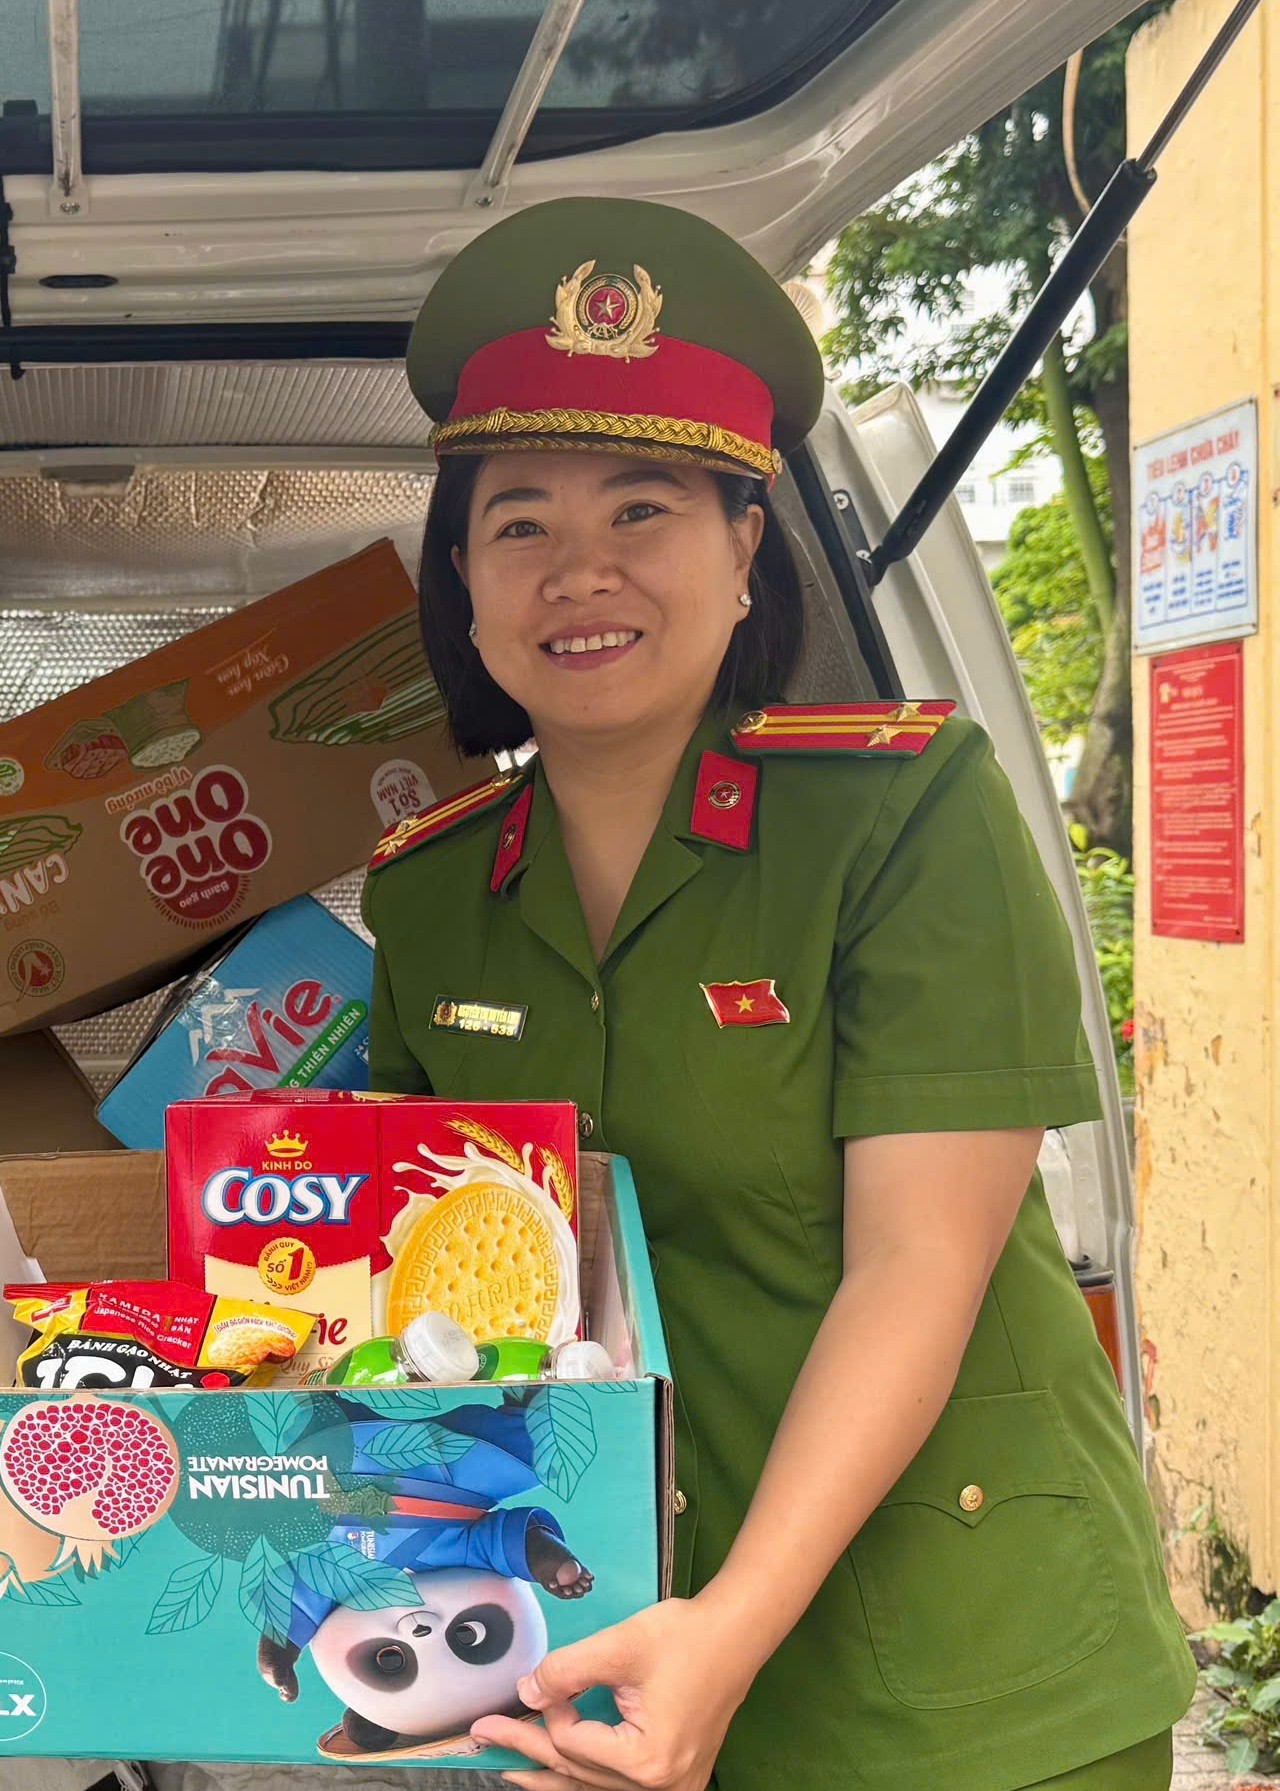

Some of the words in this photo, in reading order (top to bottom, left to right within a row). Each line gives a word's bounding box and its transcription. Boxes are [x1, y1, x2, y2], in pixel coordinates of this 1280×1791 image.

[123, 768, 246, 856] One
[143, 817, 270, 896] One
[205, 979, 335, 1096] aVie
[297, 1043, 330, 1079] THIÊN
[327, 1007, 361, 1047] NHIÊN
[262, 1161, 292, 1171] KINH
[294, 1161, 313, 1171] DO
[201, 1166, 370, 1226] COSY
[288, 1247, 305, 1281] 1
[94, 1306, 136, 1323] Japanese
[138, 1321, 155, 1336] Rice
[157, 1334, 192, 1349] Cracker
[99, 1293, 161, 1322] KAMEDA
[67, 1338, 118, 1353] BÁNH
[117, 1344, 149, 1357] GẠO
[148, 1353, 192, 1379] NHẬT
[186, 1455, 328, 1472] POMEGRANATE
[188, 1474, 331, 1500] TUNISIAN
